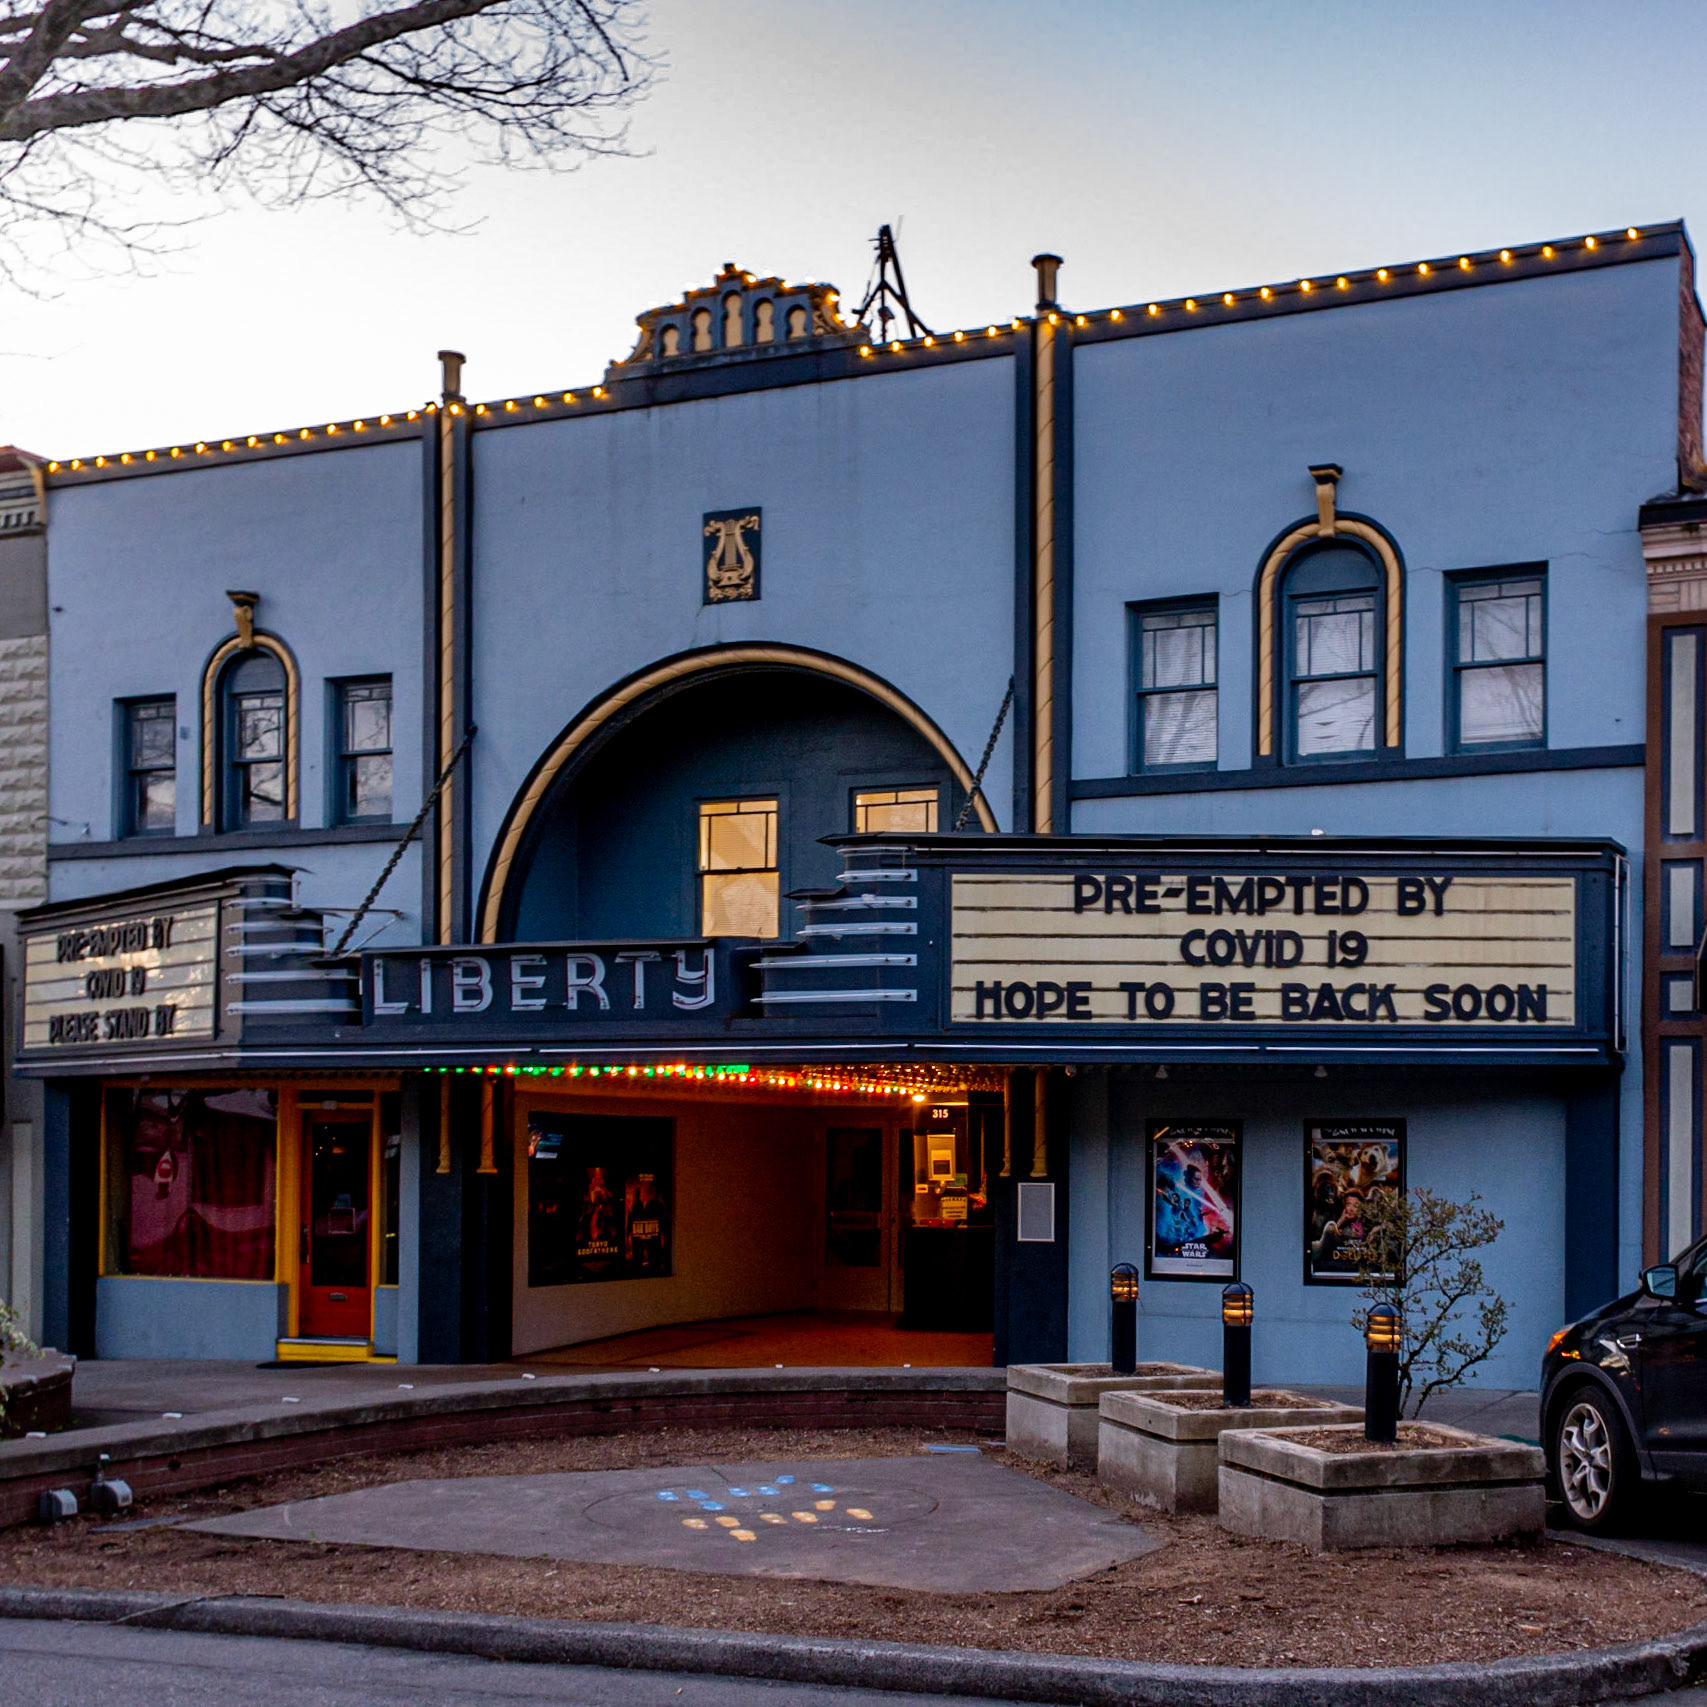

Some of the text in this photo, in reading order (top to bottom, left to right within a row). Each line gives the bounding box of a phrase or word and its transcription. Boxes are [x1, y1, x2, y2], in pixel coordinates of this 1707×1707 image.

[1074, 875, 1453, 916] PRE-EMPTED BY
[152, 916, 174, 949] BY
[1180, 929, 1369, 968] COVID 19
[85, 966, 147, 999] COVID 19
[372, 948, 715, 1015] LIBERTY
[975, 981, 1547, 1022] HOPE TO BE BACK SOON
[49, 1010, 99, 1044] PLEASE
[102, 1007, 150, 1040] STAND
[932, 1109, 949, 1119] 315
[1181, 1242, 1208, 1250] STAR
[1181, 1250, 1208, 1258] WARS
